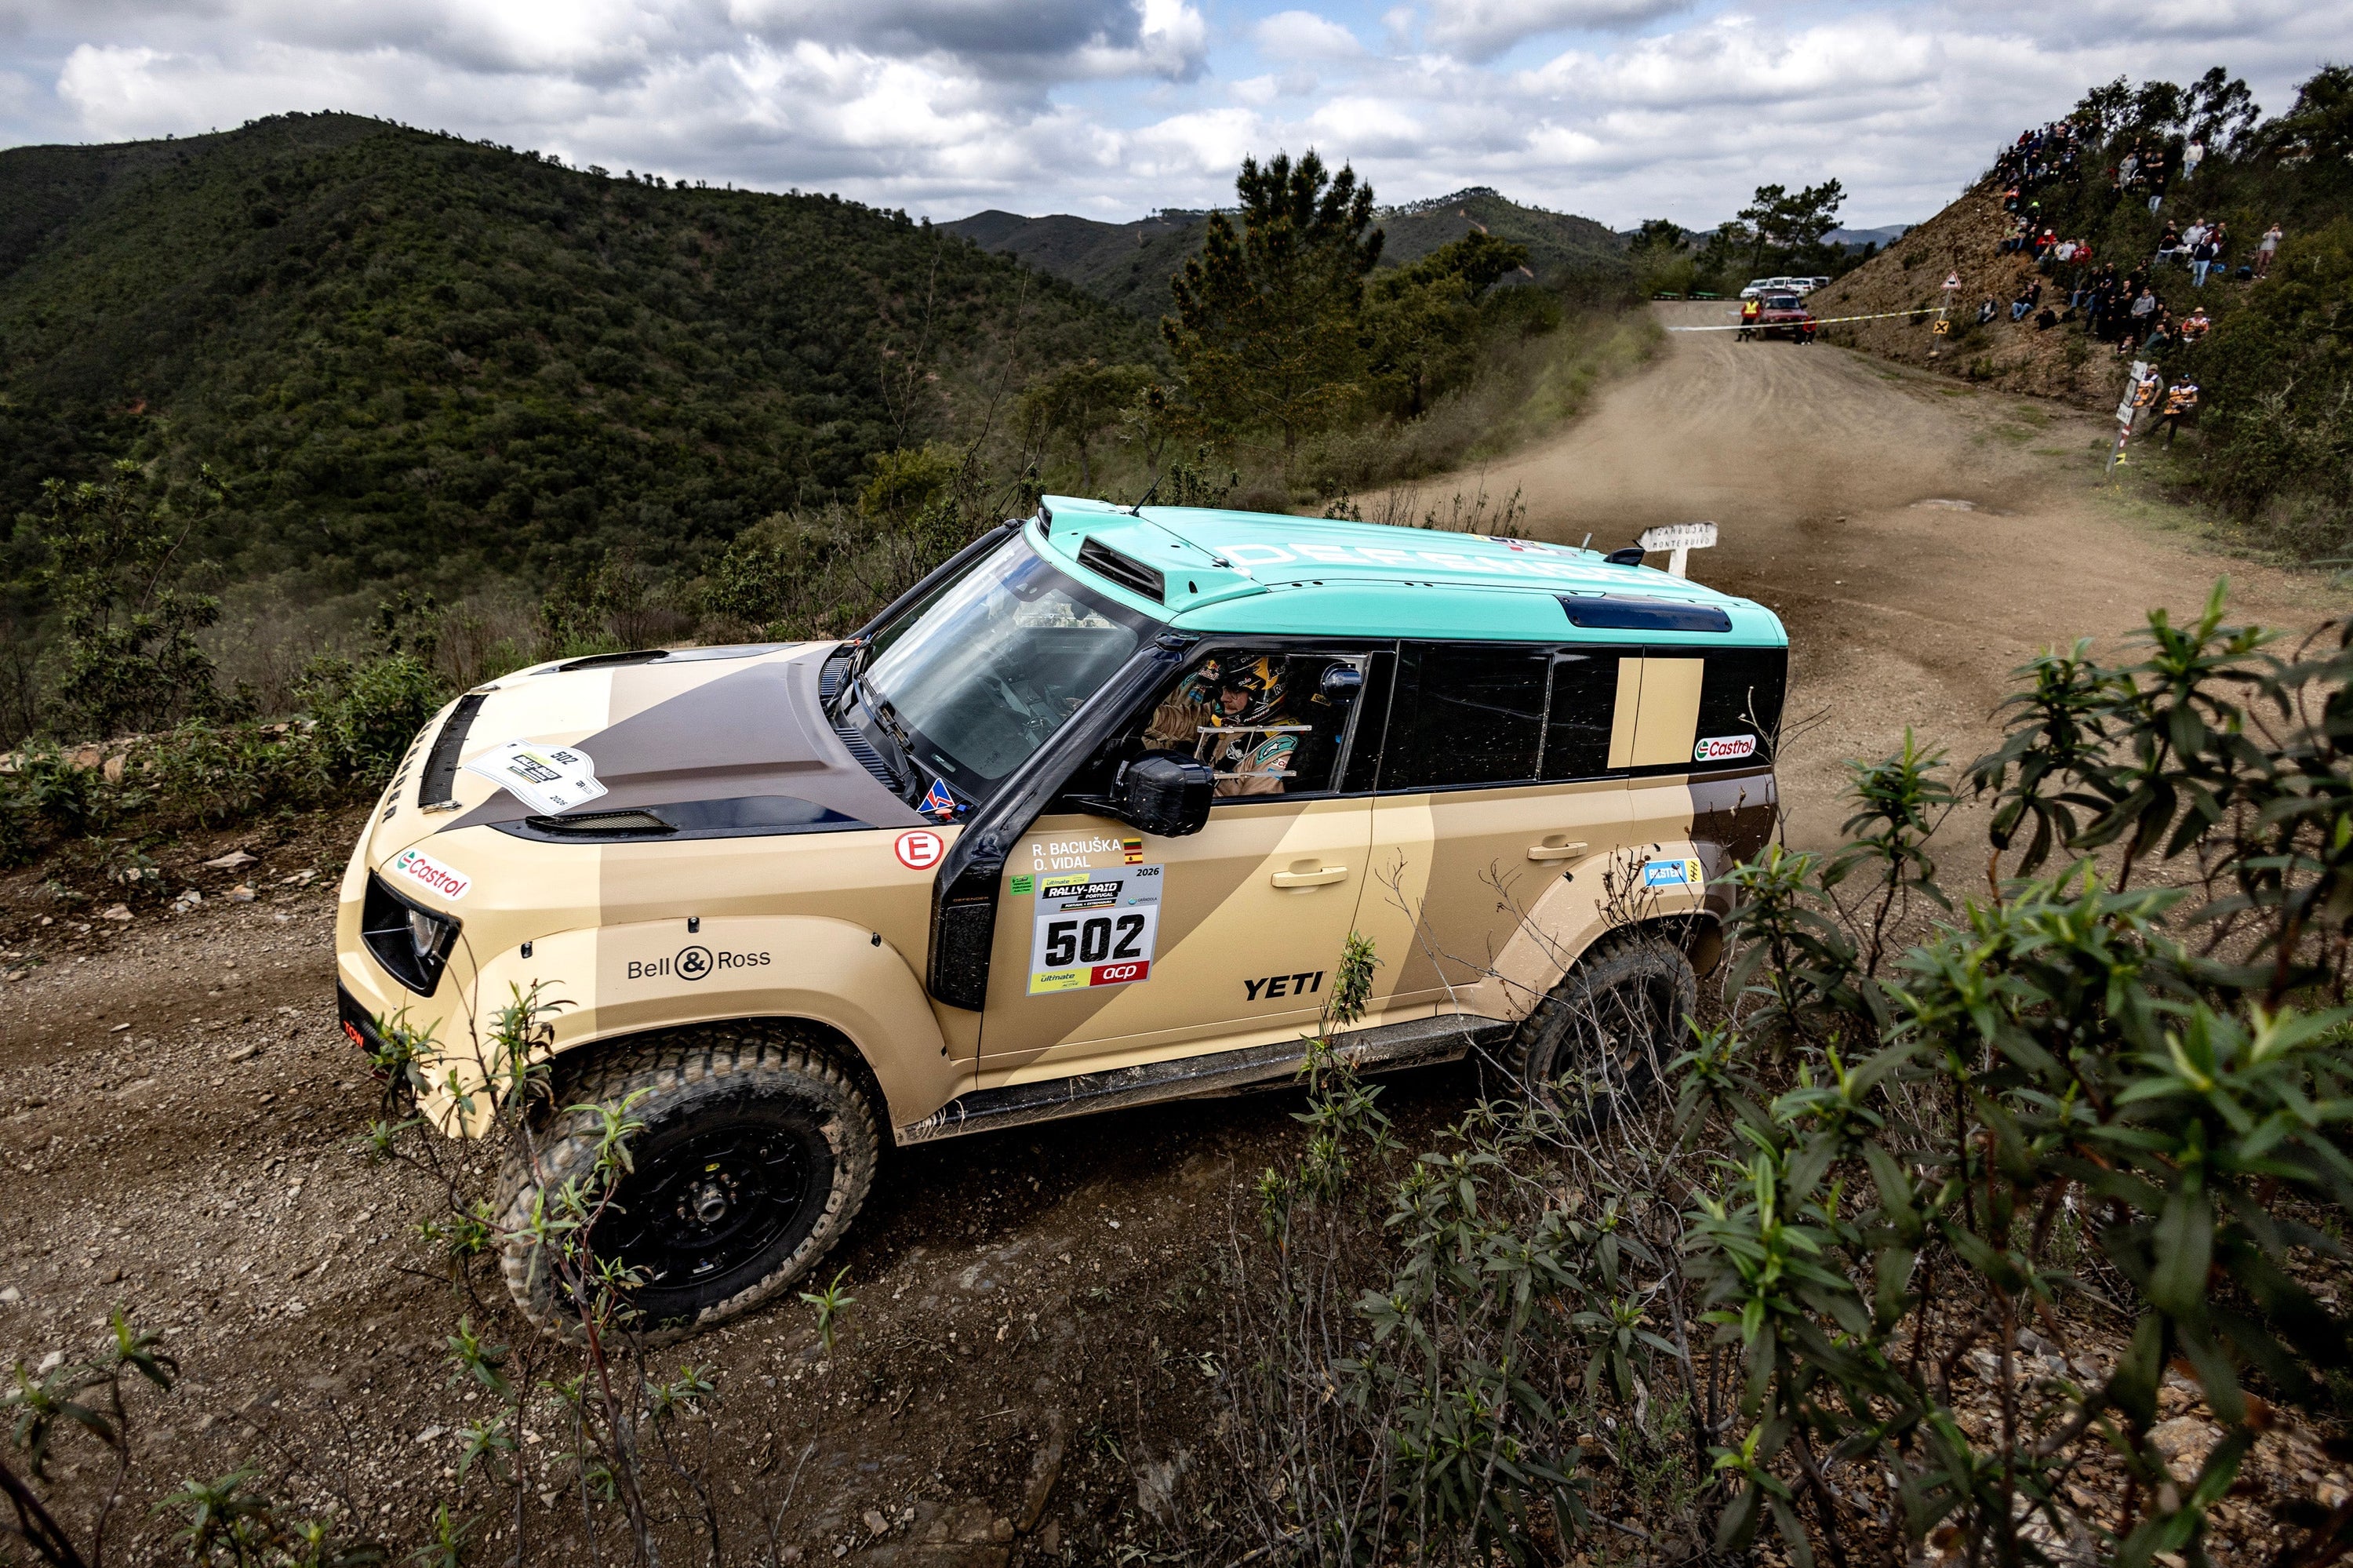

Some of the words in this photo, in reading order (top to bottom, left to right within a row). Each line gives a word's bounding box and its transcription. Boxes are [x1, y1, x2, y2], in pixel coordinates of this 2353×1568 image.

[1657, 525, 1709, 536] ZAMBUJAL
[1653, 540, 1680, 548] MONTE
[1685, 537, 1710, 546] RUIVO
[1710, 738, 1754, 757] Castrol
[550, 751, 579, 765] 502
[907, 835, 931, 860] E
[1031, 844, 1046, 857] R.
[1049, 837, 1122, 856] BACIUŠKA
[1033, 858, 1048, 871] O.
[1049, 856, 1091, 870] VIDAL
[409, 858, 467, 897] Castrol
[1136, 867, 1160, 877] 2026
[1049, 882, 1118, 897] RALLY-RAID
[1045, 913, 1145, 967] 502
[627, 957, 670, 980] Bell
[682, 951, 705, 973] &
[718, 951, 771, 970] Ross
[1103, 964, 1137, 980] acp
[1040, 973, 1075, 982] ultimate
[1243, 970, 1325, 1002] YETI
